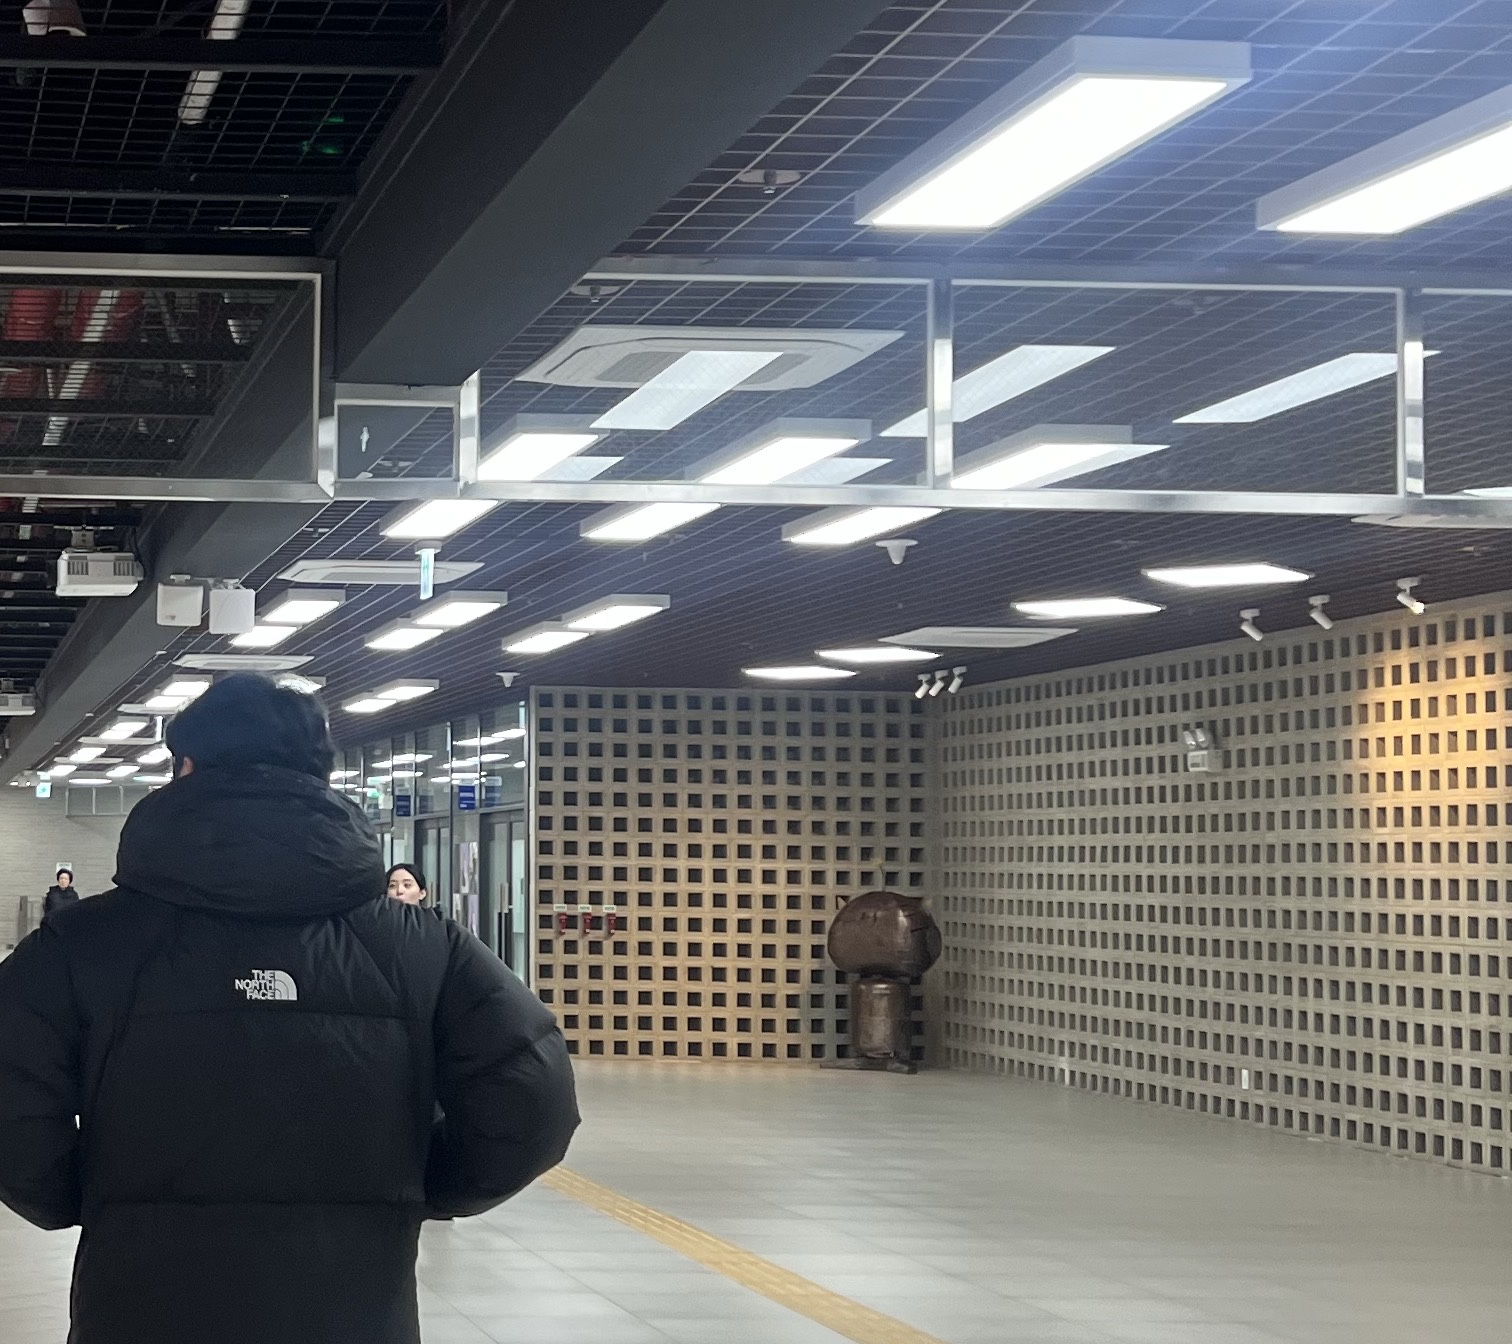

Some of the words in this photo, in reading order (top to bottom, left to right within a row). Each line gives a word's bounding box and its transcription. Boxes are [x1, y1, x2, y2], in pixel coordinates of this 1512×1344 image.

[251, 969, 275, 980] THE
[234, 979, 275, 990] NORTH
[246, 990, 275, 1000] FACE
